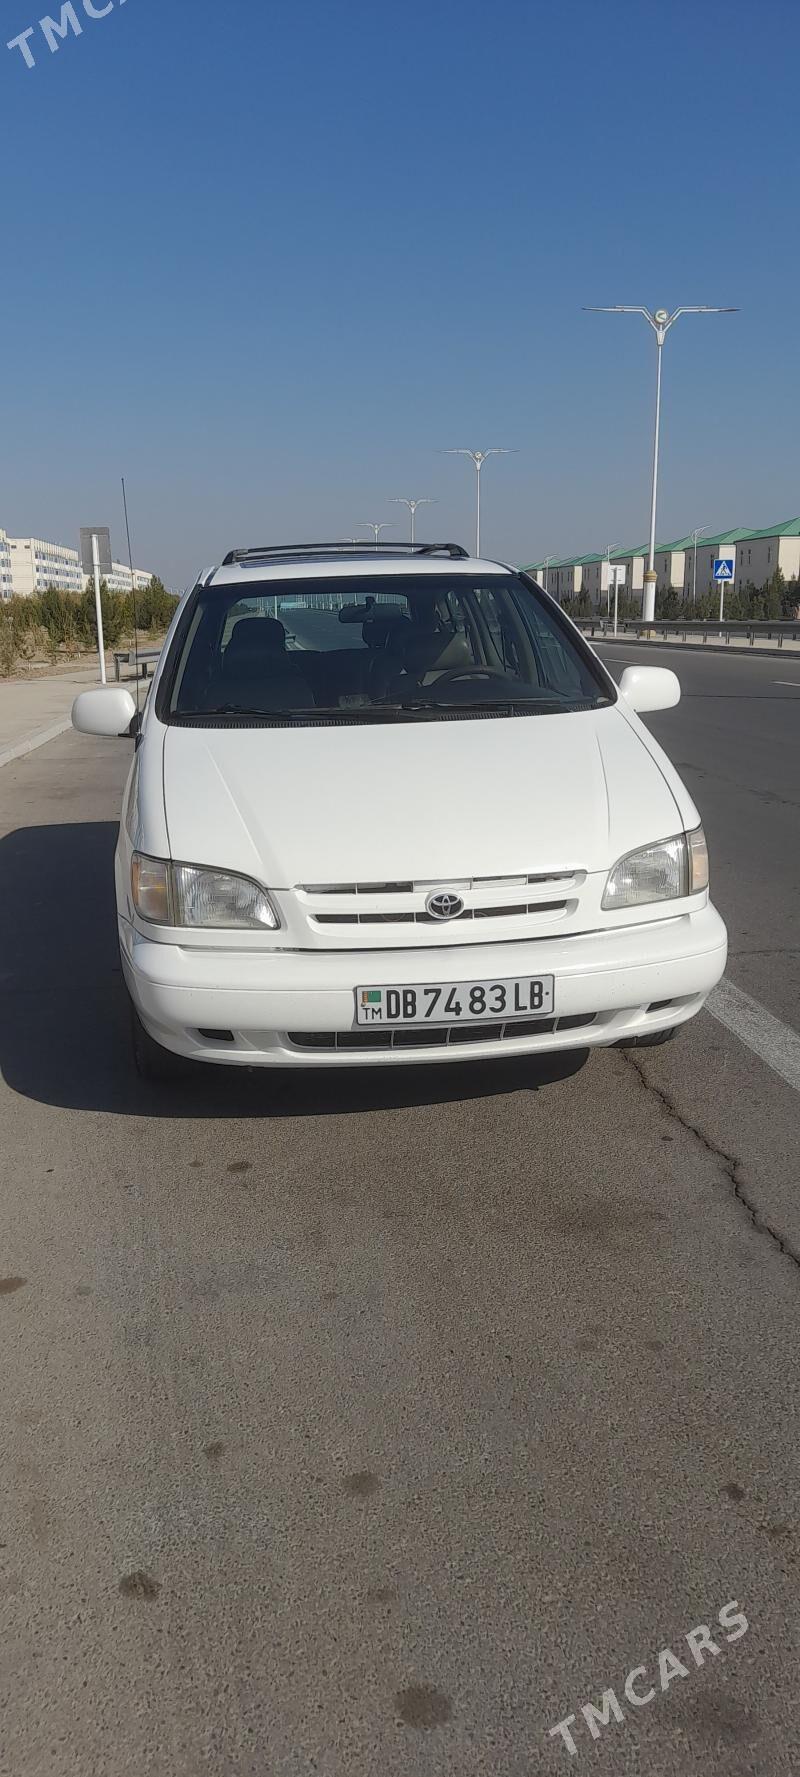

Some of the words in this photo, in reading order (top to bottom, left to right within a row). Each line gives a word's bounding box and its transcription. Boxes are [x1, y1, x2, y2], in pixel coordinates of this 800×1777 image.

[386, 989, 416, 1019] DB
[514, 981, 543, 1011] LB
[363, 1007, 382, 1020] TM
